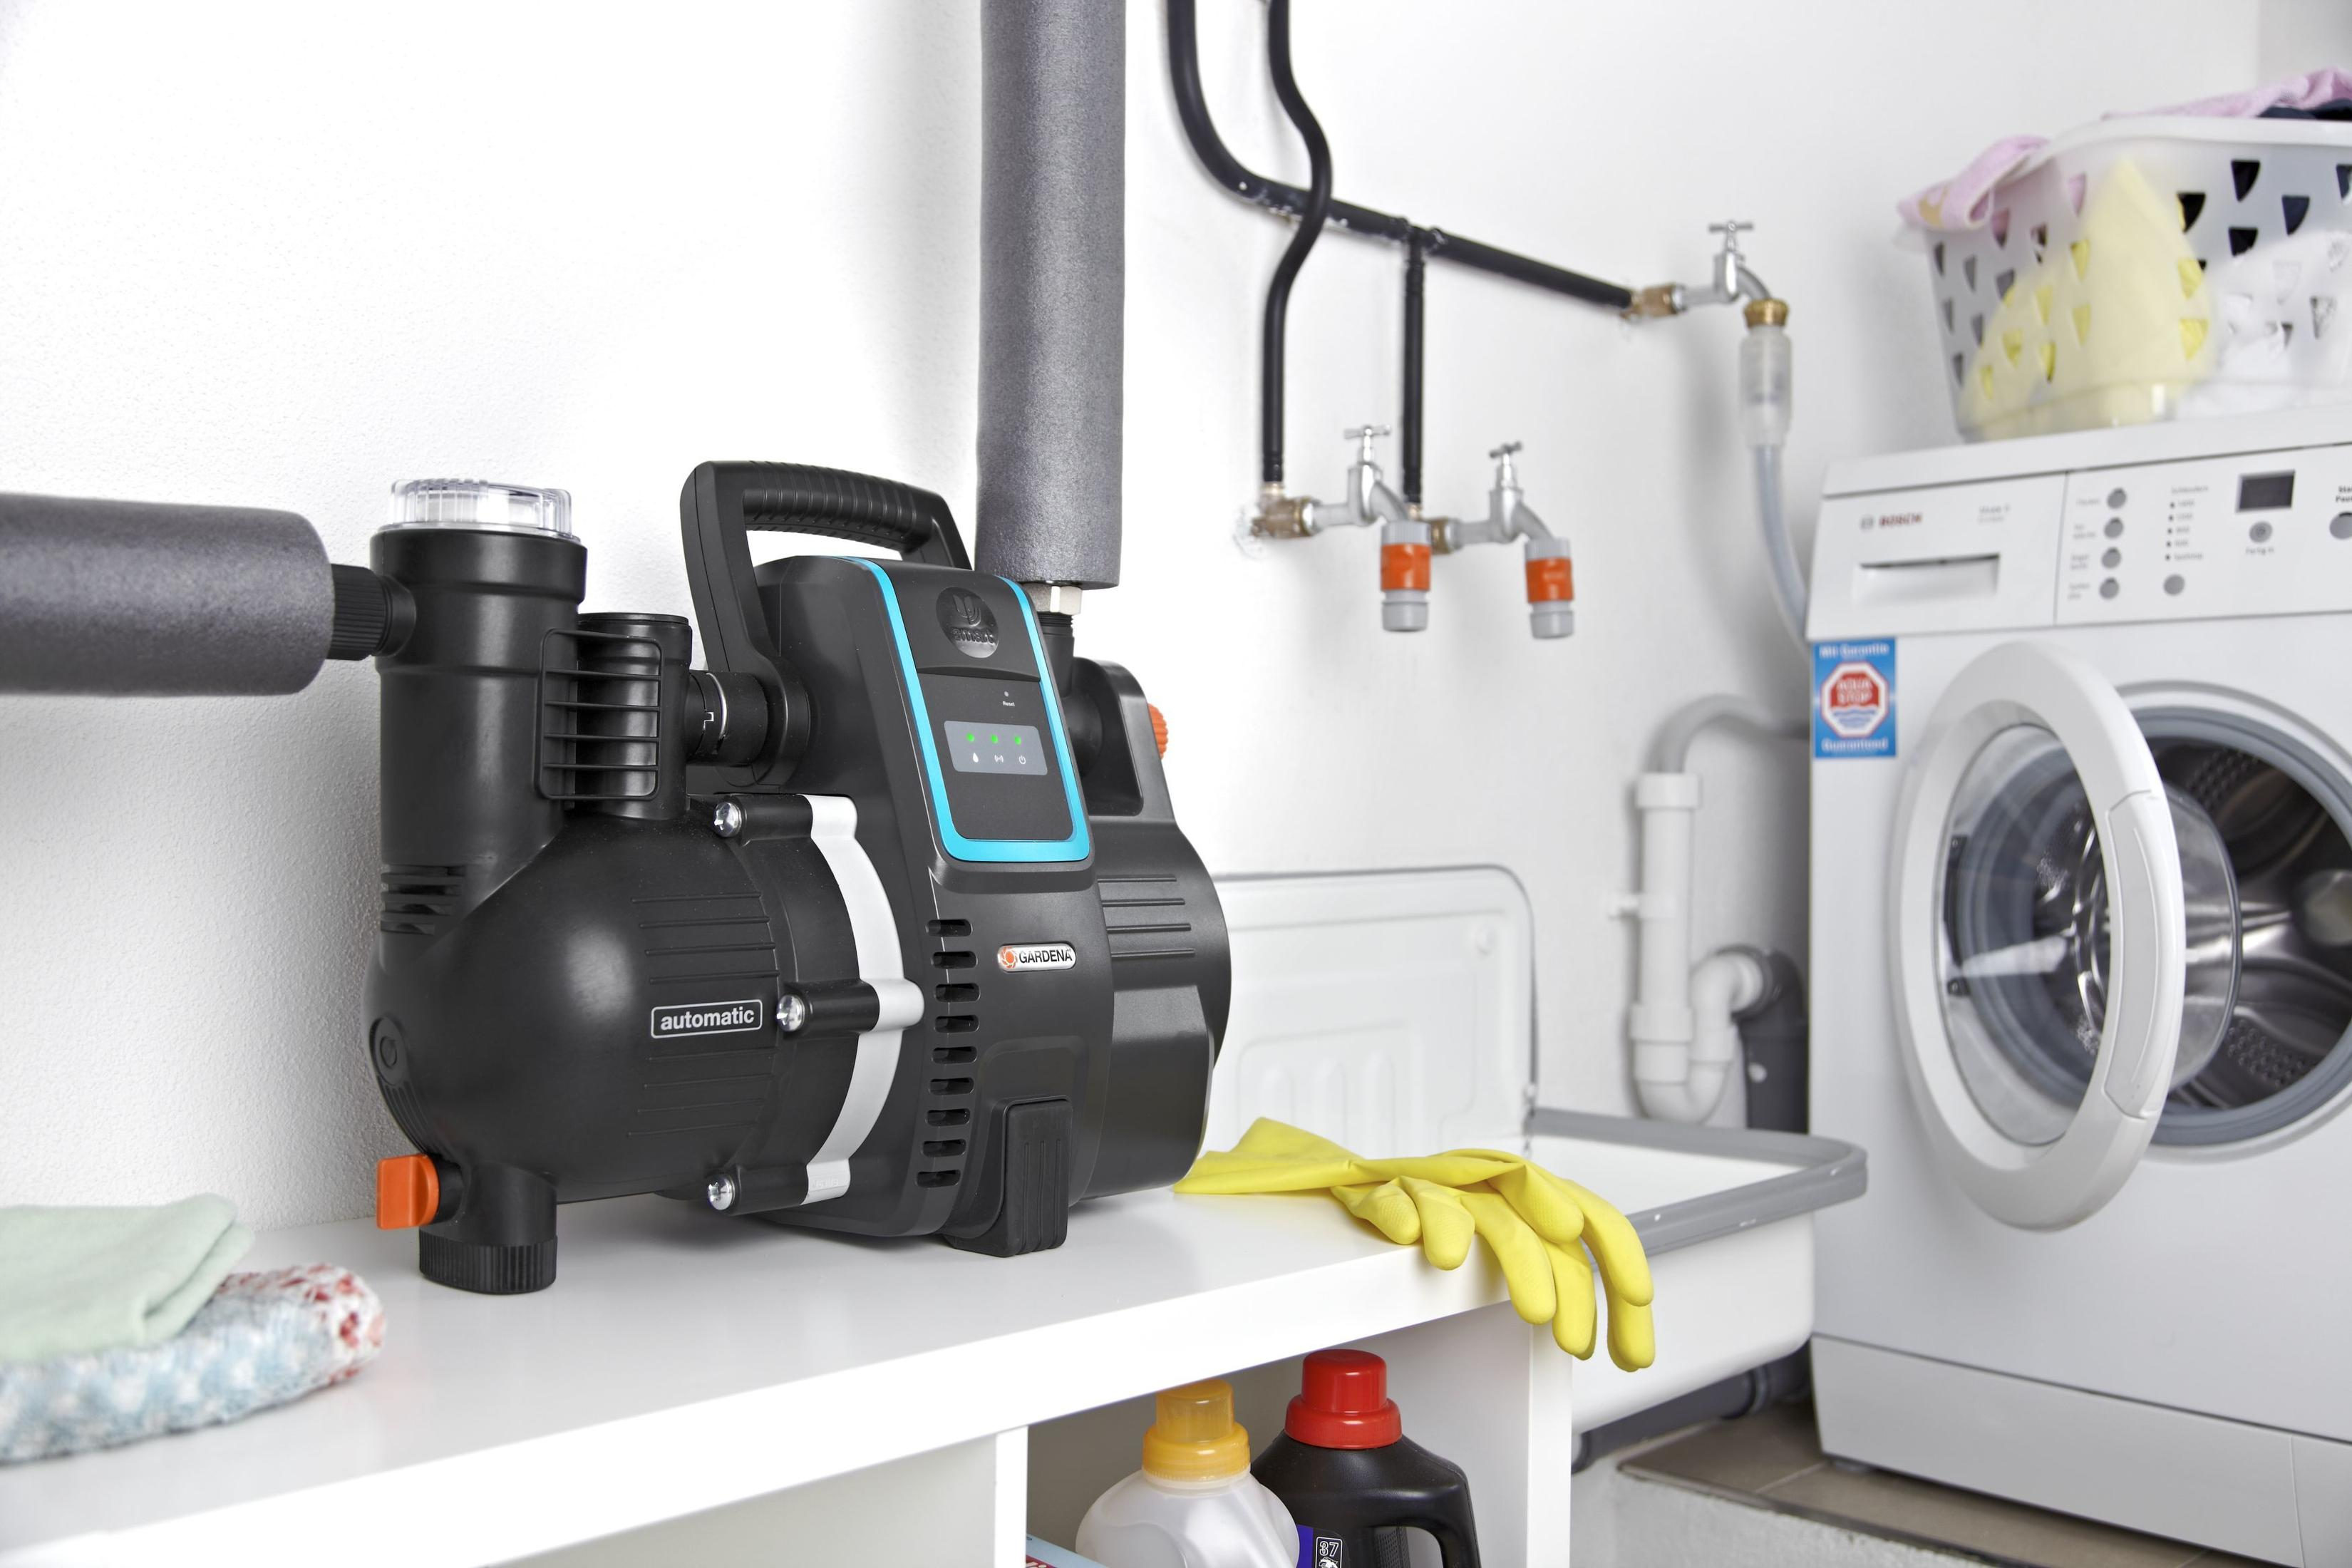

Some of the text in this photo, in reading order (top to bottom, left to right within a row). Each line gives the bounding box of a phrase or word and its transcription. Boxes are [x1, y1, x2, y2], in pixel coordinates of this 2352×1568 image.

[1879, 512, 1923, 528] BOSCH
[1019, 949, 1073, 964] GARDENA
[660, 1006, 755, 1031] automatic
[1319, 1541, 1339, 1557] 37
